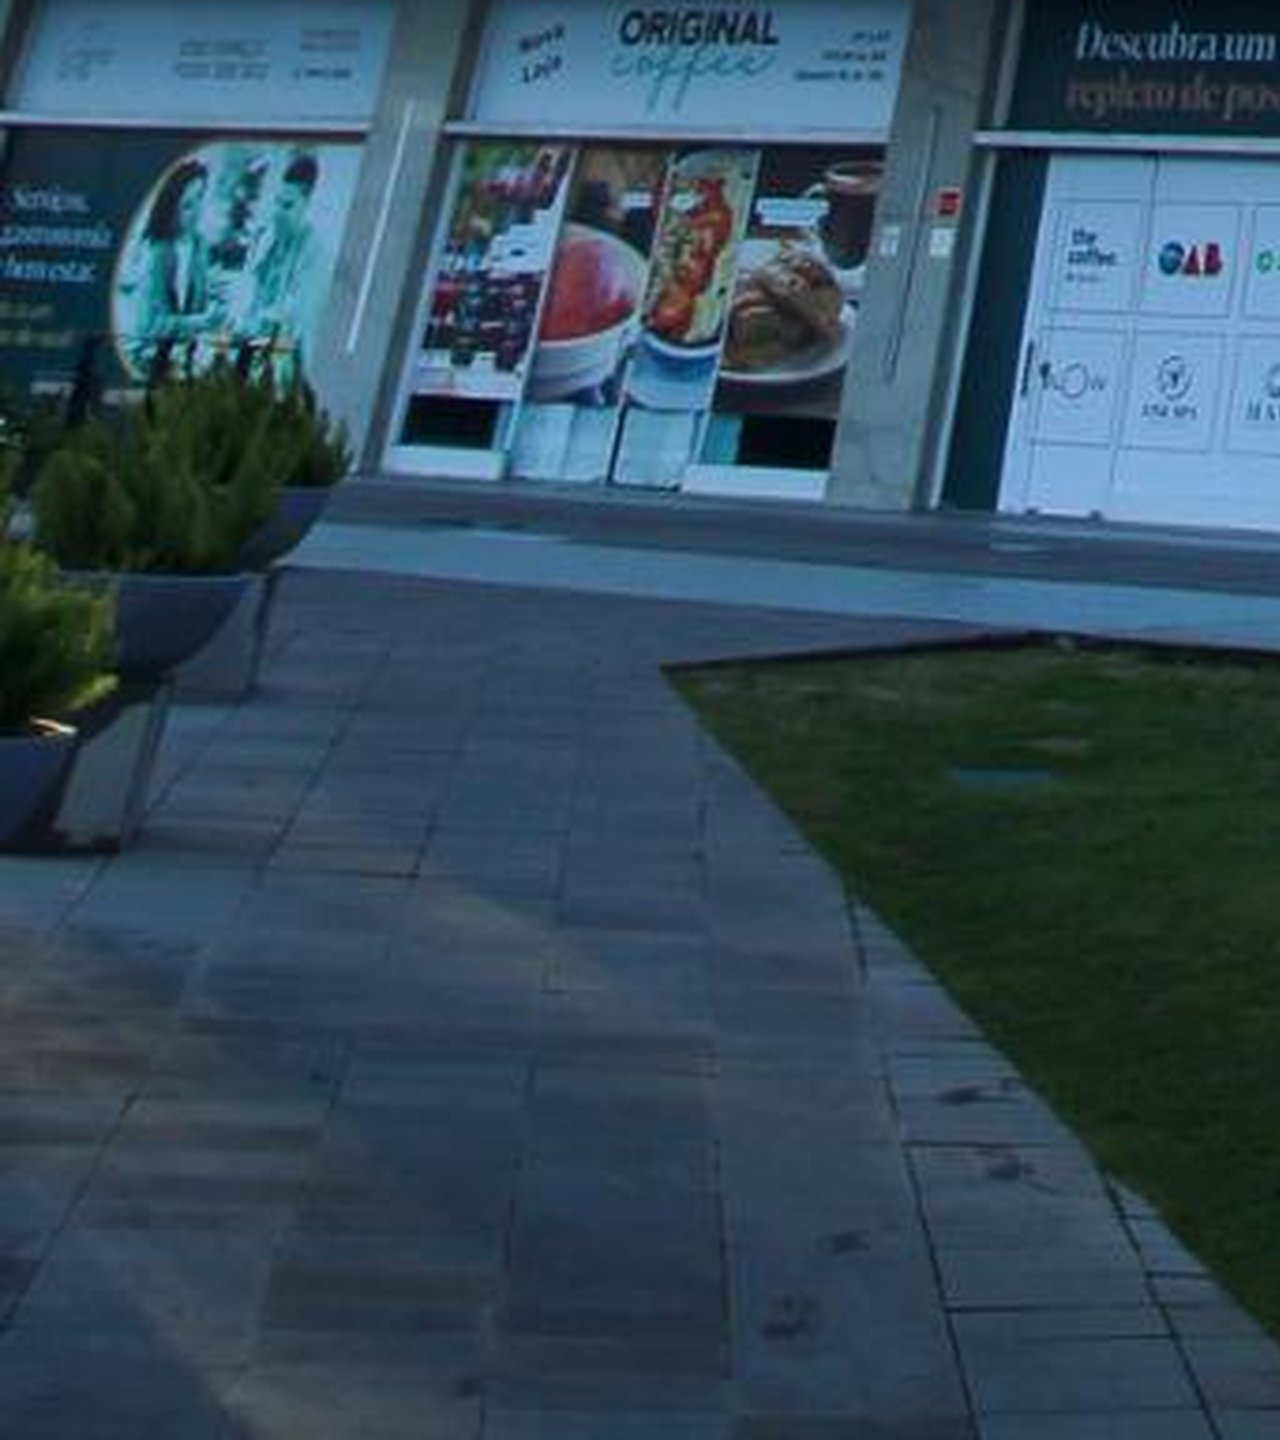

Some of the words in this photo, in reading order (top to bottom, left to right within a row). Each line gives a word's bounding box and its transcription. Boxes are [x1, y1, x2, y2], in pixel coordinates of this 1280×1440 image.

[620, 9, 780, 45] ORIGINAL
[1076, 20, 1217, 62] Descubra
[1224, 33, 1276, 62] um
[1181, 69, 1221, 111] de
[1158, 241, 1223, 277] OAB
